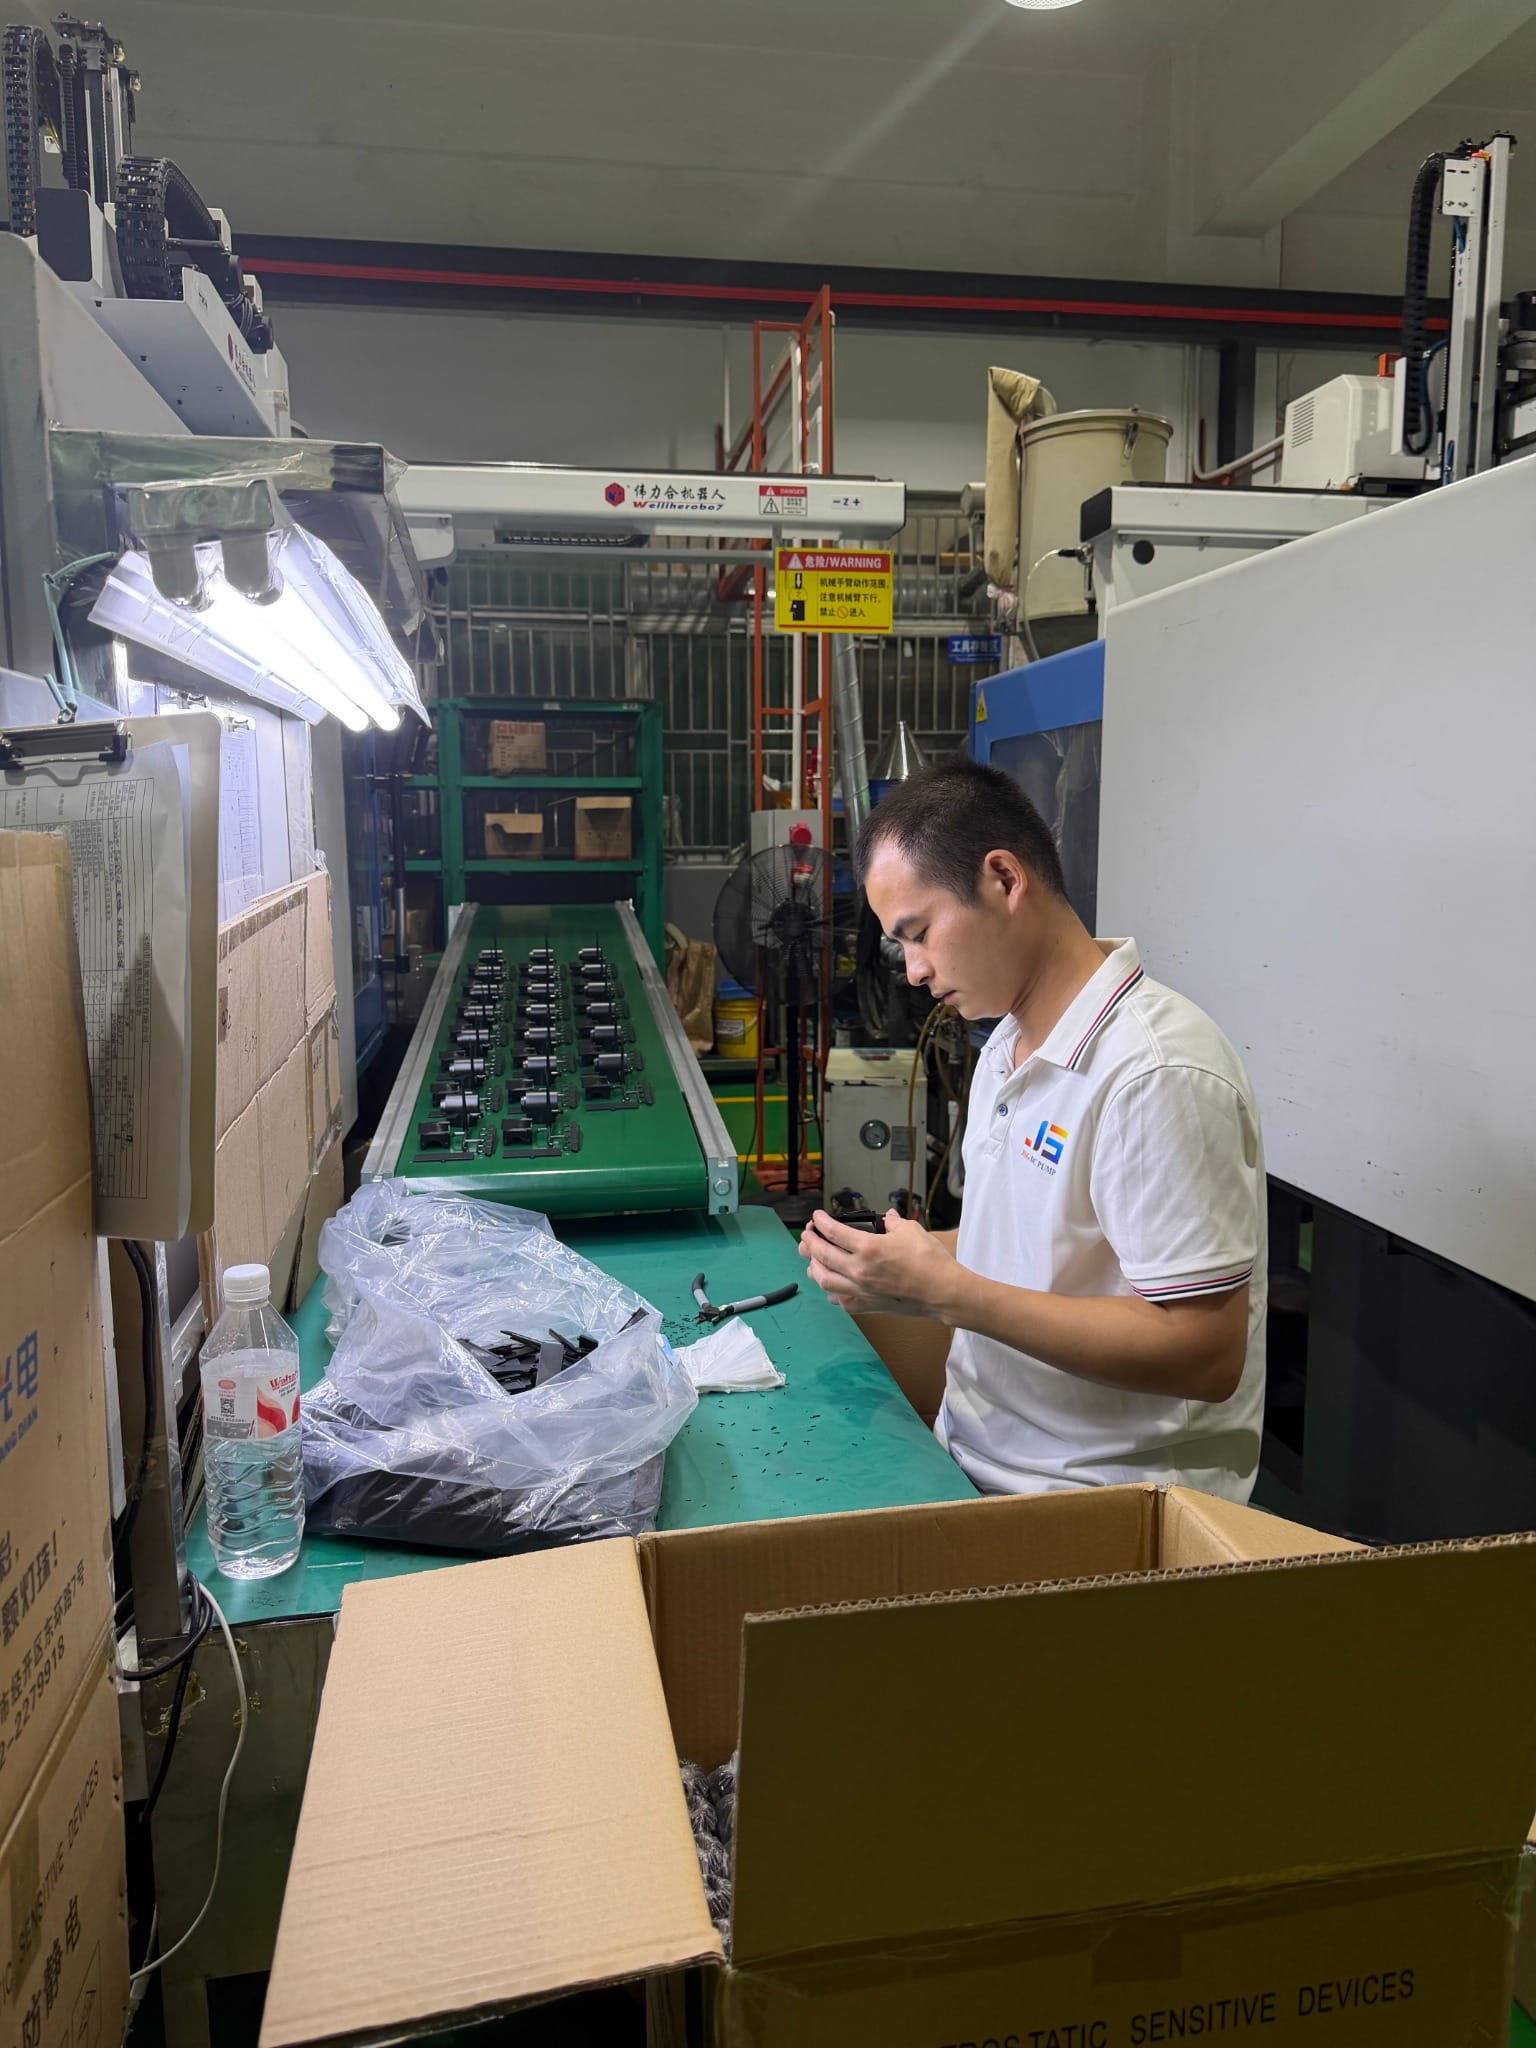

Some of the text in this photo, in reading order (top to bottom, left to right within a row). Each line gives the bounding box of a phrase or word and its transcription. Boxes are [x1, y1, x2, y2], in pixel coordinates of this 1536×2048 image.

[634, 482, 726, 500] 伟力合机器人
[804, 555, 882, 569] 危险/WARNING
[68, 1760, 99, 1848] DEVICES
[1130, 1992, 1277, 2045] SENSITIVE
[1298, 1969, 1415, 2017] DEVICES
